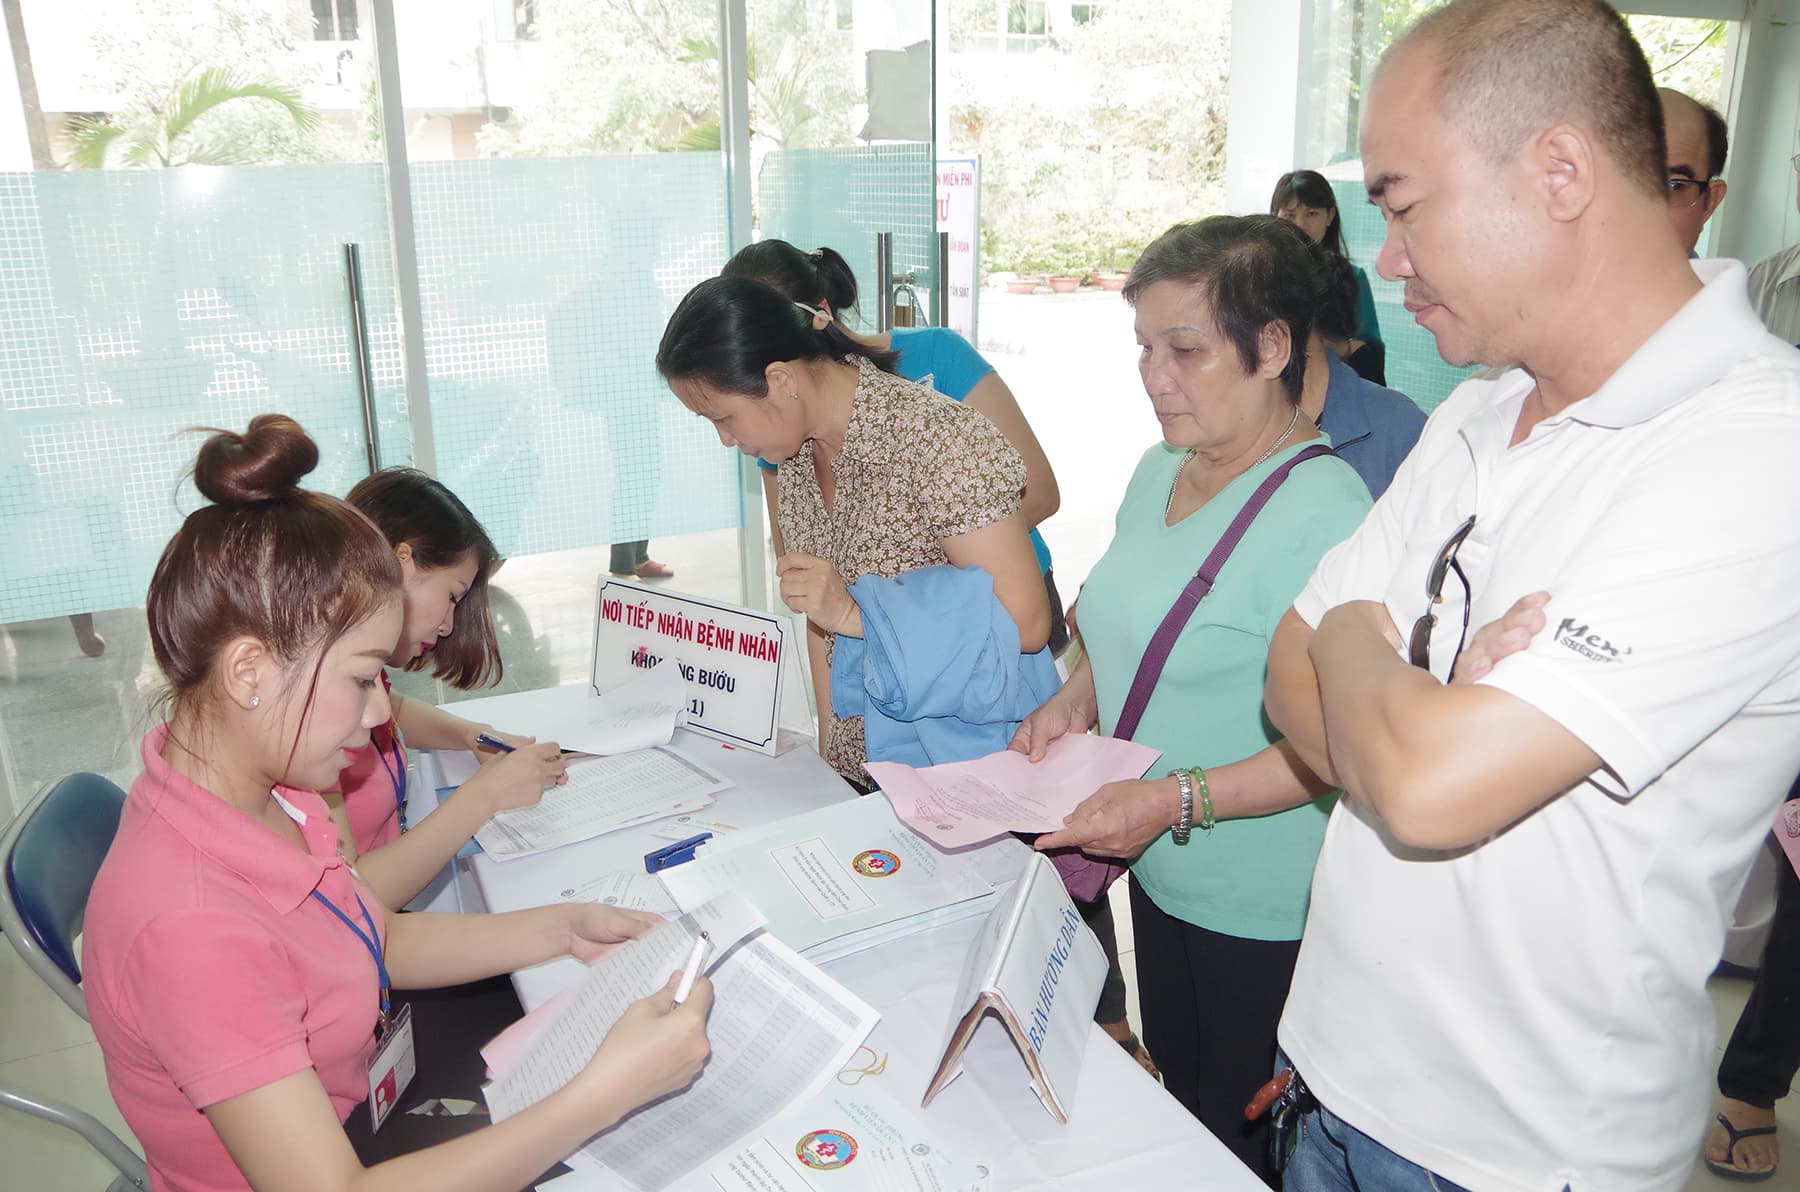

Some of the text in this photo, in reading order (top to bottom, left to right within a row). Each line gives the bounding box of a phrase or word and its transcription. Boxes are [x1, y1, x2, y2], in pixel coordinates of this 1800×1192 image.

[602, 598, 778, 663] NƠI TIẾP NHẬN BỆNH NHÂN
[678, 663, 695, 682] NG
[698, 669, 735, 693] BƯỚU
